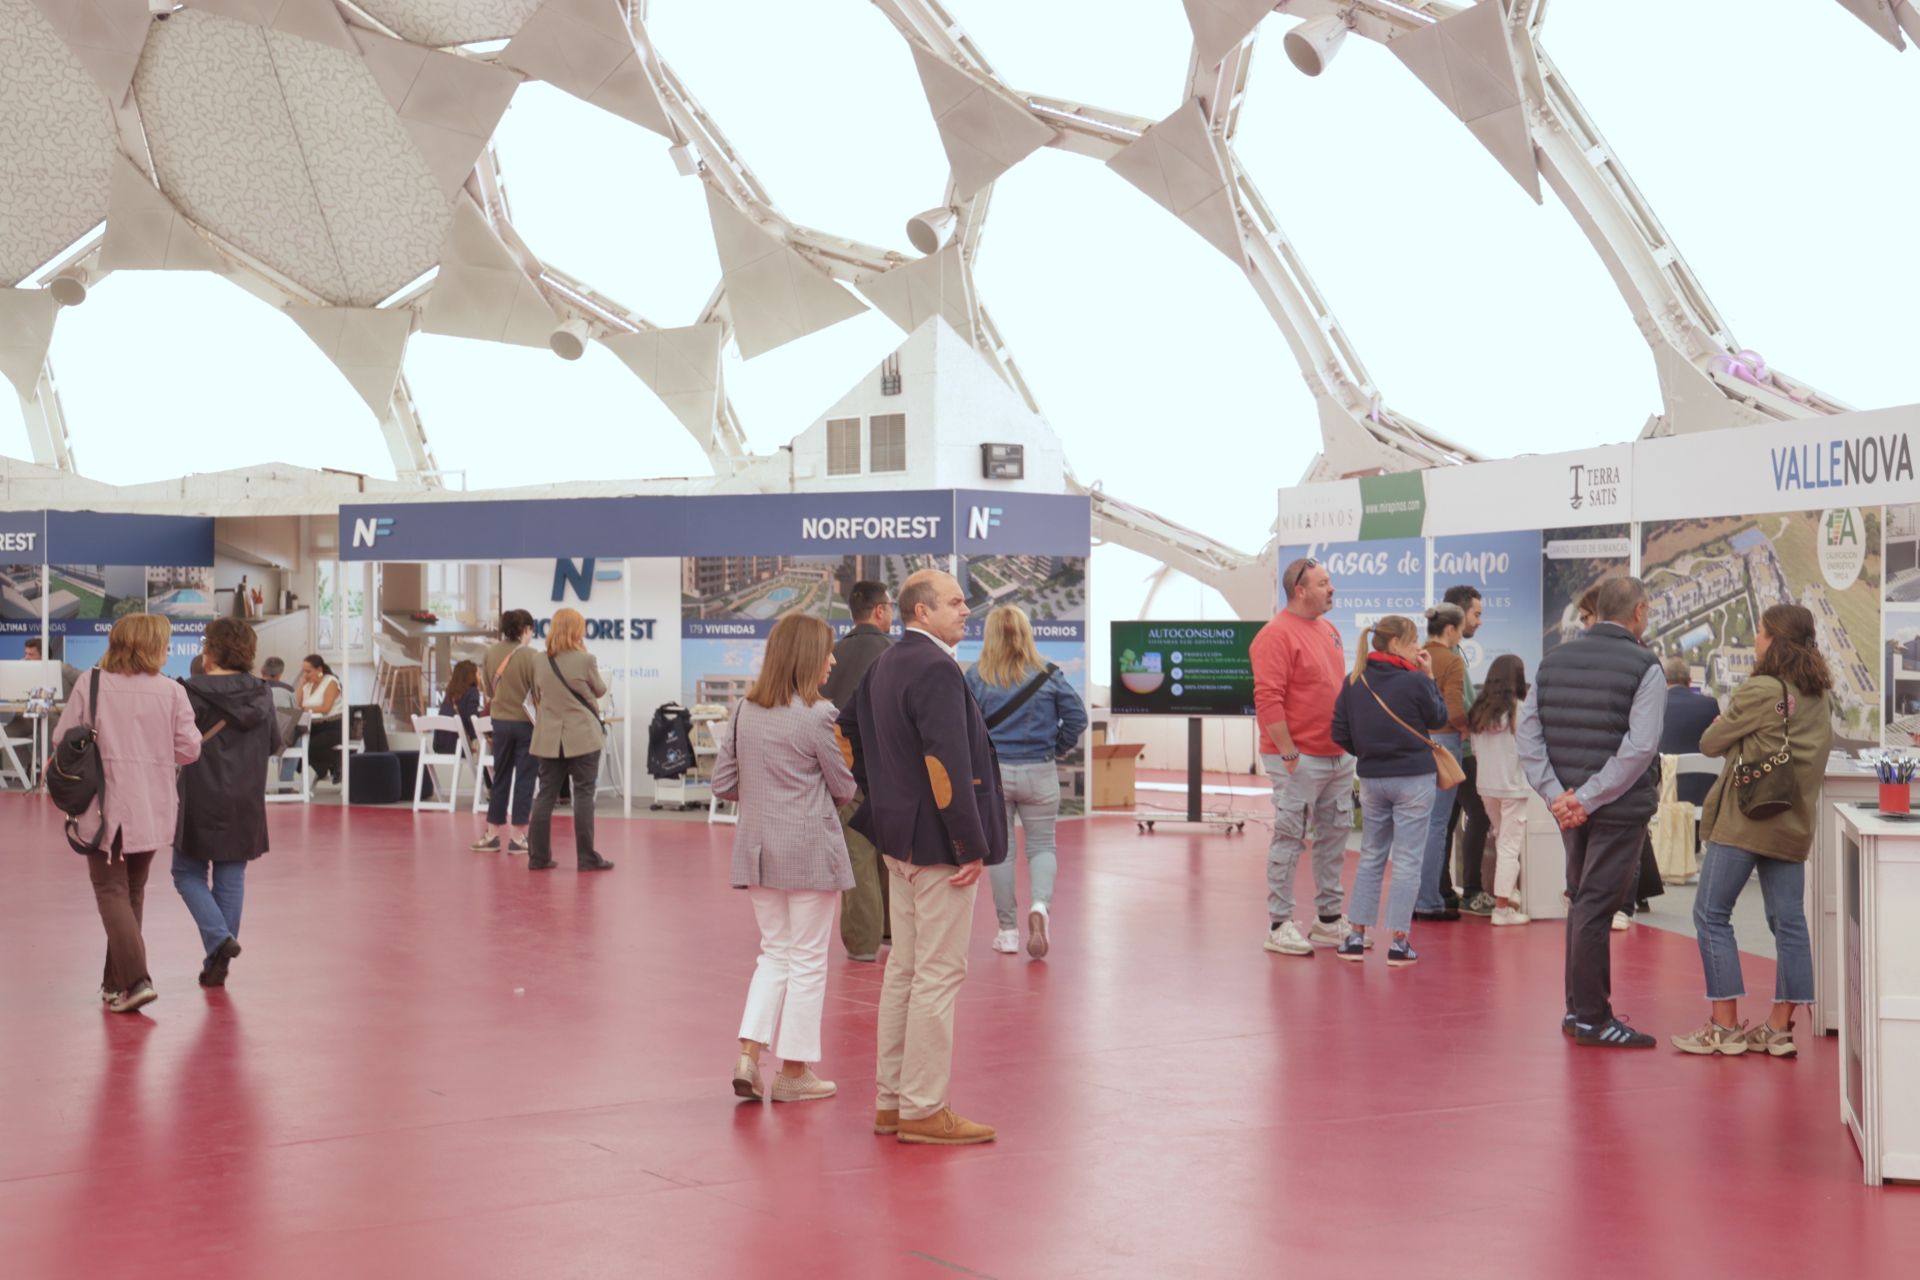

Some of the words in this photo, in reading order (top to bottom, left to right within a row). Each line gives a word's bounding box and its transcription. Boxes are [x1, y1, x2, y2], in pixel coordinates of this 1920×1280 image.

[1771, 432, 1914, 491] VALLENOVA
[1586, 466, 1621, 487] TERRA
[1588, 487, 1617, 507] SATIS
[802, 515, 942, 541] NORFOREST
[1397, 550, 1422, 576] de
[1336, 598, 1382, 608] ENDAS
[533, 617, 657, 641] OOREST
[704, 623, 756, 635] VIVIENDAS
[1033, 625, 1078, 637] ITORIOS
[1148, 628, 1235, 638] AUTOCONSUMO
